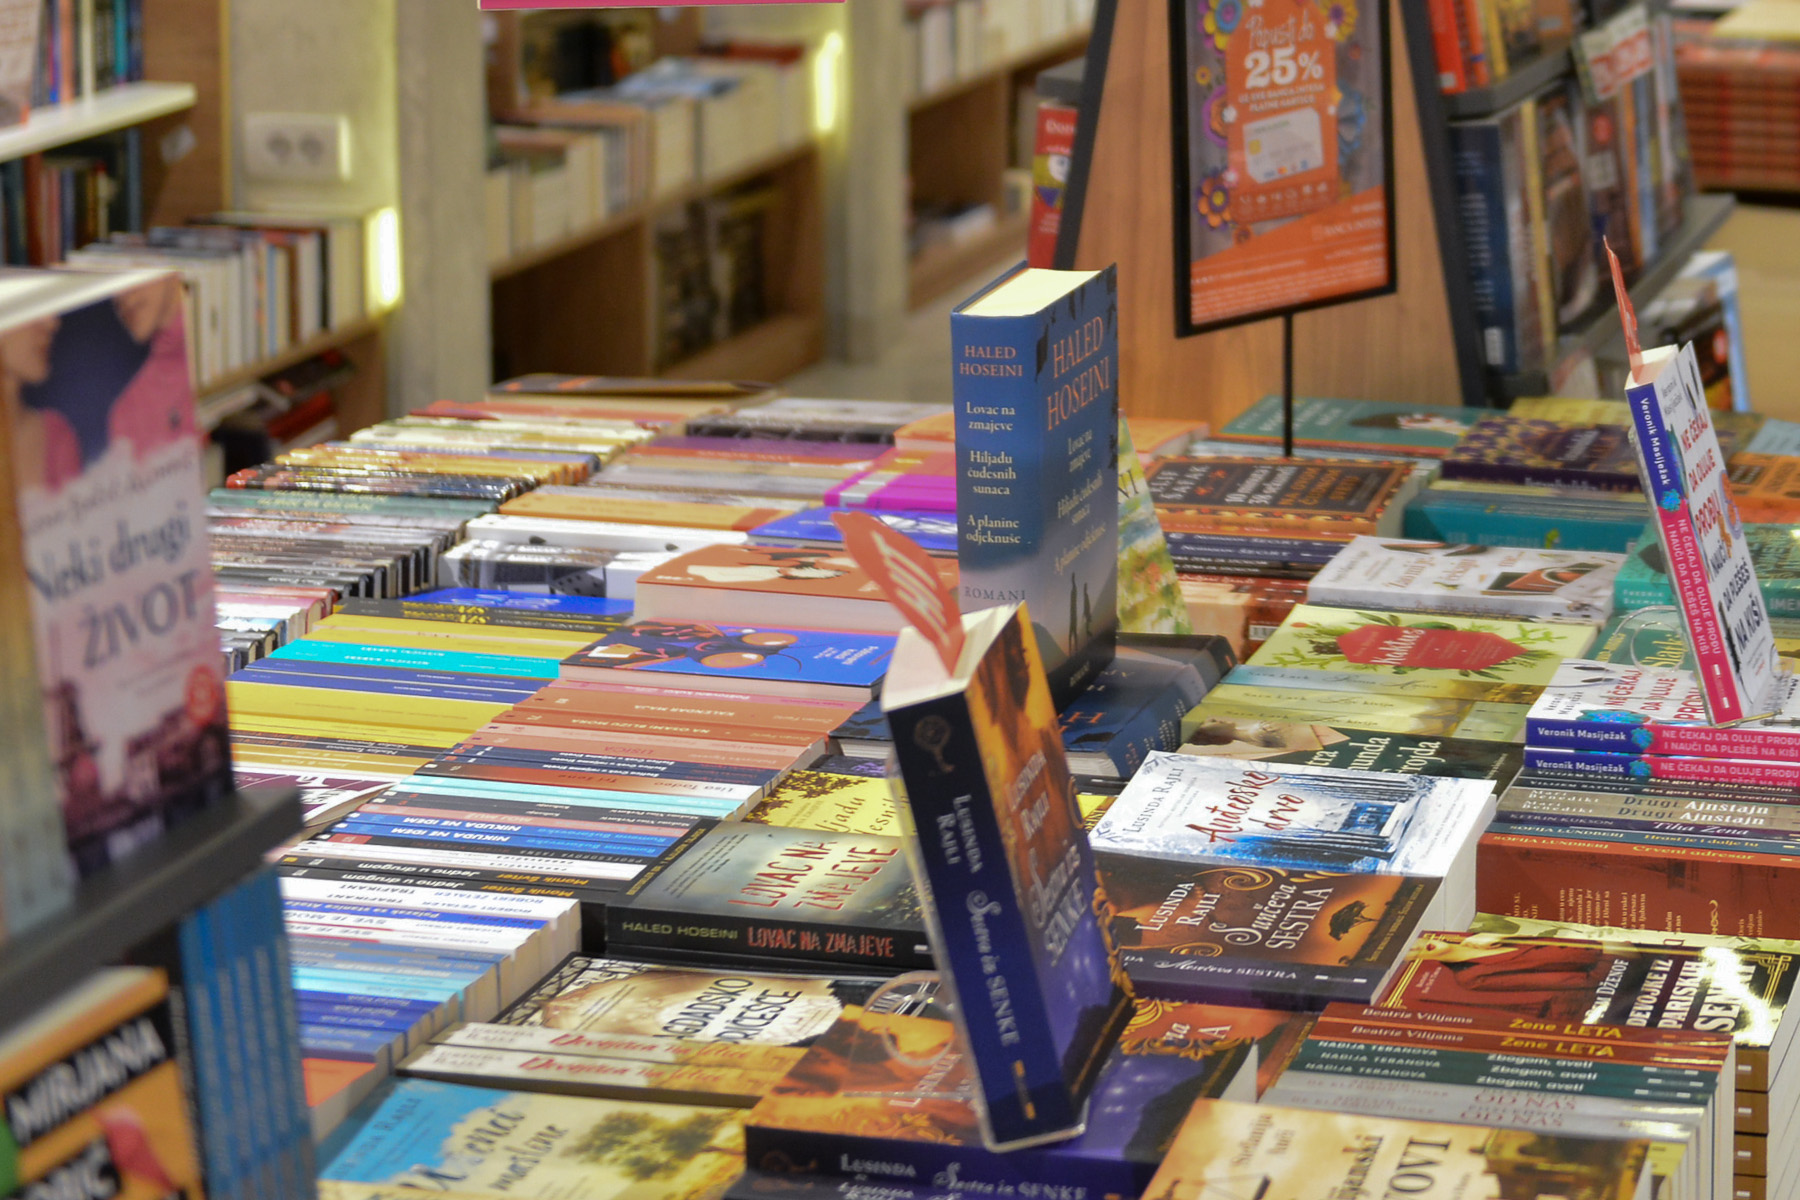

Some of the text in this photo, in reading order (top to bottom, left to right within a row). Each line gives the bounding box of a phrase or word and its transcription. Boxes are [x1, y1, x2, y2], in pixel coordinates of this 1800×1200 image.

[1244, 46, 1324, 90] 25%
[964, 345, 1017, 359] HALED
[1053, 316, 1105, 379] HALED
[959, 363, 1024, 377] HOSEINI
[1047, 355, 1110, 431] HOSEINI
[966, 402, 1016, 416] Lovac na
[968, 419, 1013, 433] zmajeve
[1640, 397, 1672, 486] Veronik Masiježak
[970, 450, 1013, 467] Hiljadu
[972, 484, 1011, 496] sunaca
[966, 514, 1020, 530] A planine
[966, 530, 1022, 545] odjeknuše
[26, 500, 191, 602] Neki drugi
[964, 586, 1026, 601] ROMANI
[1669, 530, 1709, 656] NAUČI PLEŠEŠ KIŠI
[1677, 518, 1722, 655] NE ČEKAJ DA OLUJE PROĐU
[79, 567, 199, 669] ŽIVOT
[1369, 626, 1428, 665] Kaktus
[670, 706, 735, 717] KALENDAR
[1538, 726, 1575, 738] Veronik
[1577, 728, 1626, 742] Masiježak
[1662, 730, 1678, 739] NE
[1679, 728, 1715, 742] ČEKAJ
[1716, 732, 1729, 742] DA
[1730, 733, 1764, 744] OLUJE
[1671, 739, 1799, 758] NAUČI PLEŠEŠ KIŠI
[1536, 759, 1800, 779] Veronik Masiježak ČEKAJ OLUJE PROĐU
[1122, 767, 1185, 834] LUSINDA RAJLI
[1623, 796, 1770, 816] Drugi Ajnštajn
[1248, 794, 1305, 831] drvo
[1617, 806, 1766, 826] Drugi Ajnštajn
[390, 827, 511, 842] NIKUDA NE IDEM
[402, 817, 522, 832] NIKUDA NE IDEM
[953, 794, 983, 875] LUSINDA
[1509, 824, 1553, 833] SOFIJA
[1652, 820, 1695, 832] Tiha
[560, 851, 643, 864] PROFESOROVA
[1493, 835, 1537, 845] SOFIJA
[1632, 845, 1687, 856] Crveni
[1689, 849, 1756, 861] adresar
[341, 873, 402, 884] drugom
[357, 862, 417, 874] drugom
[430, 867, 481, 878] Jedno
[496, 872, 541, 883] Šviter
[794, 846, 900, 911] ZMAJEVE
[416, 878, 466, 889] Jedno
[480, 884, 526, 895] Šviter
[544, 875, 589, 885] Monik
[728, 860, 815, 908] LOVAC
[339, 884, 544, 905] ROBERT ZETALER TRAFIKANT
[530, 886, 574, 897] Monik
[327, 894, 532, 915] ROBERT ZETALER TRAFIKANT
[1134, 881, 1196, 932] LUSINDA
[1175, 892, 1221, 927] RAJLI
[1208, 884, 1298, 946] Sunčeva
[1266, 885, 1334, 950] SESTRA
[622, 921, 895, 958] HALED HOSEINI LOVAC NA ZMAJEVE
[1235, 967, 1297, 980] SESTRA
[1603, 957, 1629, 998] DŽENOF
[1625, 958, 1674, 1028] DEVOJKE IZ
[1656, 959, 1702, 1030] PARISKIH
[986, 974, 1021, 1048] SENKE
[1362, 1007, 1623, 1040] Beatriz Vilijams Žene LETA
[1352, 1025, 1616, 1058] Beatriz Vilijams Žene LETA
[1320, 1051, 1598, 1081] NADIJA TERANOVA Zbogom, aveti
[8, 1016, 167, 1147] MIRJANA
[1305, 1062, 1585, 1092] NADIJA TERANOVA Zbogom, aveti
[840, 1153, 917, 1178] LUSINDA
[1018, 1182, 1088, 1200] SENKE
